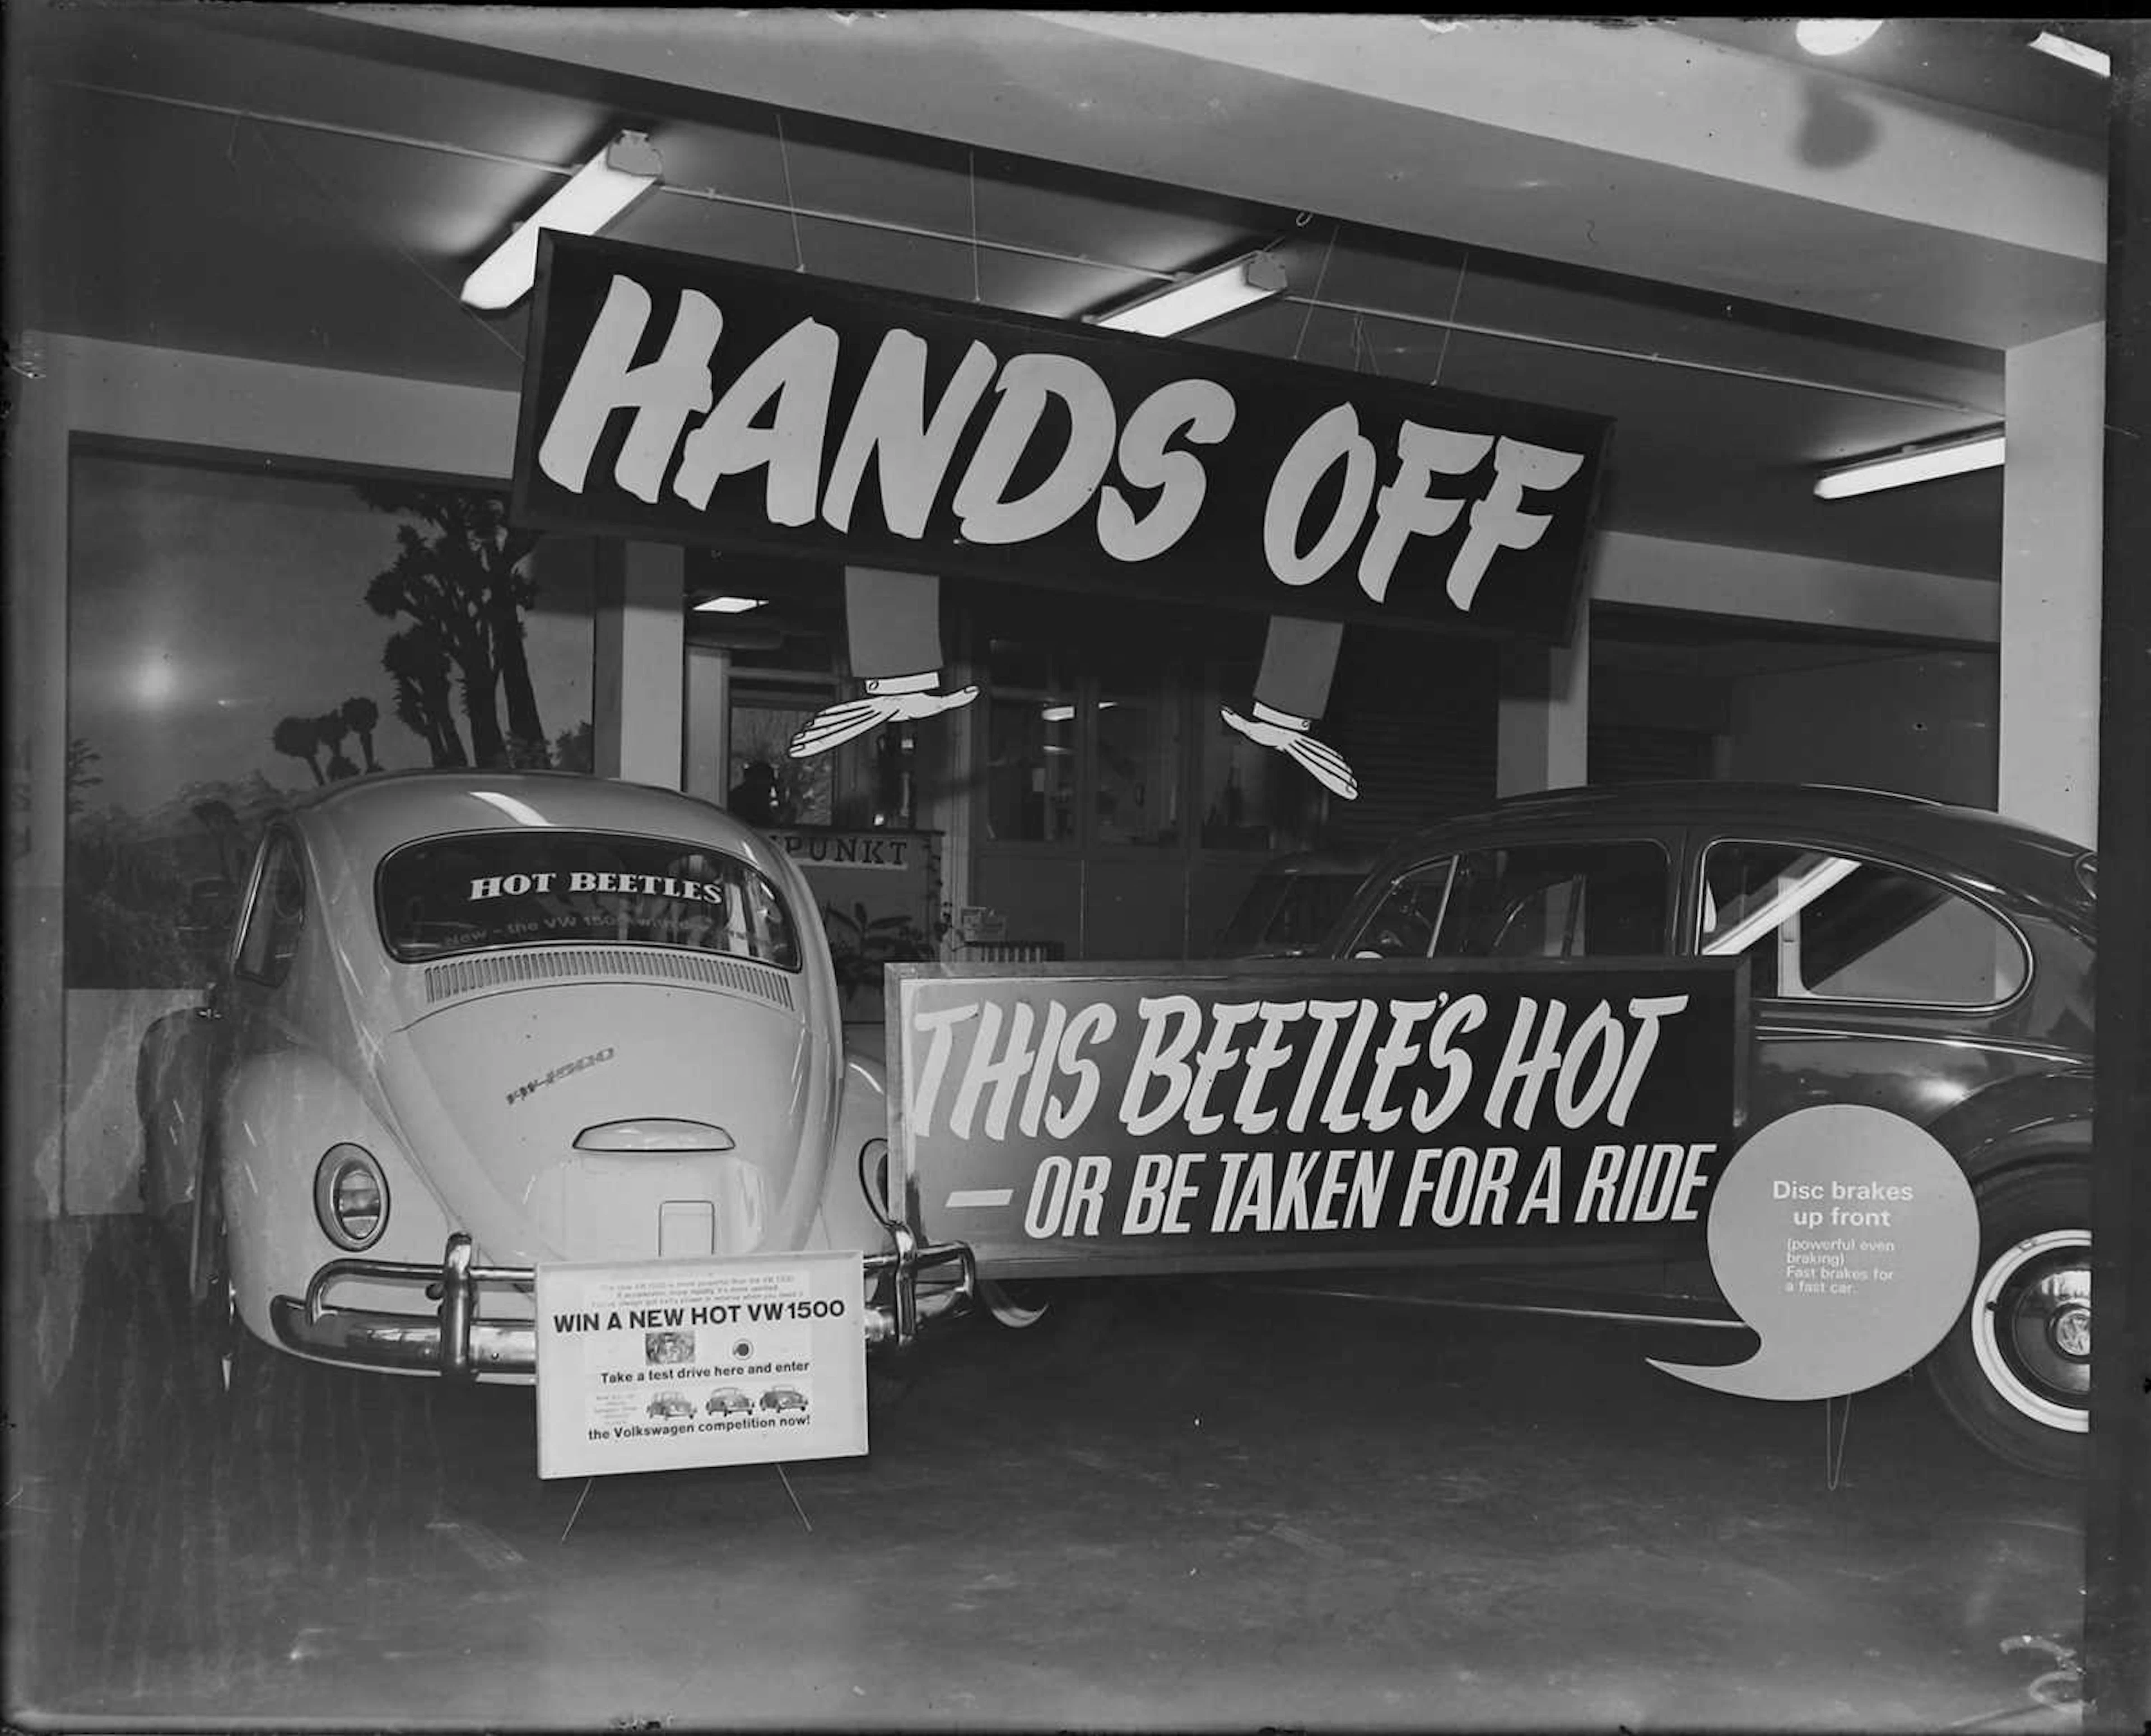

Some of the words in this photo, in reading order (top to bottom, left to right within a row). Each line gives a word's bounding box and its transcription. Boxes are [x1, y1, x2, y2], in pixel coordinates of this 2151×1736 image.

[539, 275, 1235, 560] HANDS
[1264, 403, 1584, 611] OFF
[770, 835, 907, 865] PUNKT
[469, 872, 556, 901] HOT
[569, 871, 723, 904] BEETLES
[914, 1000, 1116, 1140] THIS
[1119, 992, 1487, 1135] BEETLE'S
[1484, 994, 1688, 1131] HOT
[1024, 1156, 1112, 1239] OR
[1122, 1153, 1207, 1235] BE
[1211, 1151, 1394, 1233] TAKEN
[1399, 1146, 1519, 1228] FOR
[1516, 1147, 1562, 1224] A
[1574, 1144, 1717, 1223] RIDE
[1773, 1180, 1824, 1200] Disc
[1832, 1180, 1914, 1201] brakes
[1794, 1210, 1823, 1229] up
[1832, 1207, 1892, 1227] front
[1860, 1241, 1894, 1251] even
[1787, 1266, 1815, 1279] Fast
[1821, 1267, 1869, 1281] brakes
[1873, 1268, 1894, 1281] for
[1799, 1280, 1825, 1292] fast
[554, 1313, 599, 1333] WIN
[607, 1312, 622, 1329] A
[629, 1309, 684, 1329] NEW
[691, 1305, 742, 1326] HOT
[747, 1302, 783, 1322] VW
[787, 1299, 846, 1319] 1500
[601, 1371, 633, 1384] Take
[637, 1373, 645, 1382] a
[648, 1369, 673, 1381] test
[677, 1366, 710, 1379] drive
[714, 1365, 744, 1377] here
[748, 1362, 772, 1375] and
[776, 1361, 811, 1373] enter
[588, 1428, 610, 1441] the
[614, 1422, 695, 1440] Volkswagen
[699, 1418, 776, 1436] competition
[779, 1415, 811, 1427] now!
